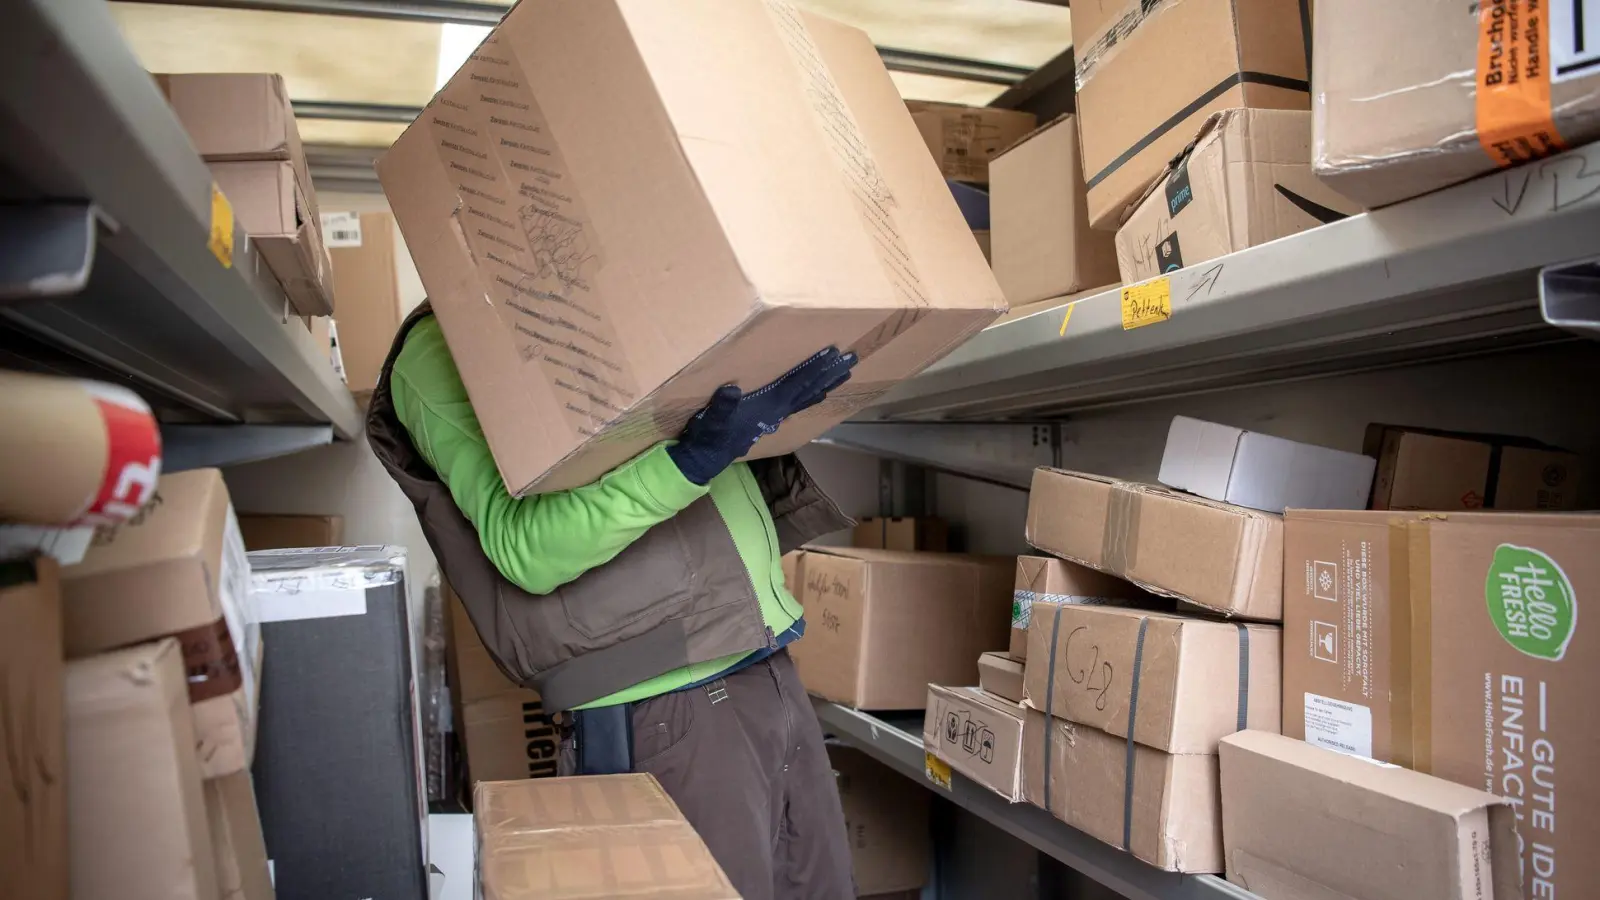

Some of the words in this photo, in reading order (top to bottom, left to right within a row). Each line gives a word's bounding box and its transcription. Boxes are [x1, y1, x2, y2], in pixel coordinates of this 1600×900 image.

[1525, 16, 1539, 79] Handle
[1171, 186, 1190, 213] prime
[1499, 572, 1530, 637] FRESH
[1514, 561, 1558, 640] Hello
[1485, 672, 1494, 771] www.HelloFresh.de
[1532, 738, 1555, 833] GUTE
